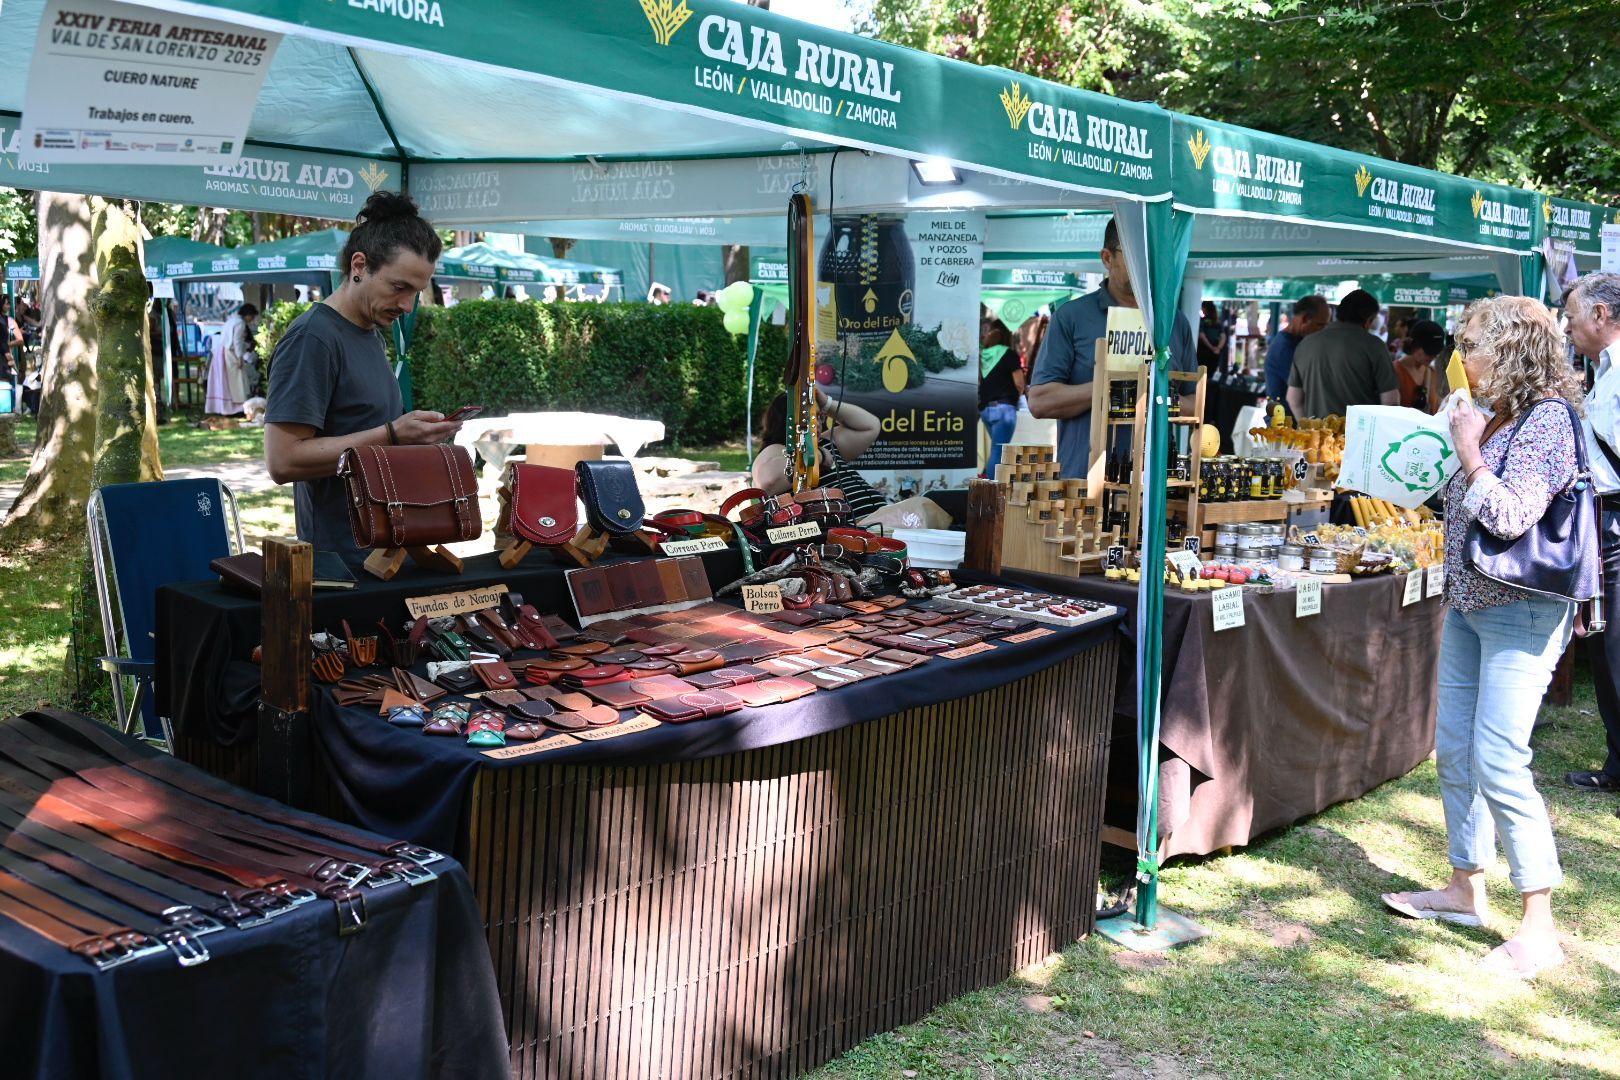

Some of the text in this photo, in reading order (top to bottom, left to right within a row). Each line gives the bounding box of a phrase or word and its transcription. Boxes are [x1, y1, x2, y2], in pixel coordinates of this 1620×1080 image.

[55, 10, 268, 51] XXIV FERIA ARTESANAL
[51, 28, 263, 66] VAL DE SAN LORENZO 2025
[698, 14, 901, 104] CAJA RURAL
[103, 69, 200, 90] CUERO NATURE
[694, 65, 734, 94] LEÓN
[750, 79, 833, 115] VALLADOLID
[846, 101, 898, 130] ZAMORA
[88, 106, 195, 125] Trabajos en cuero.
[1028, 101, 1153, 160] CAJA RURAL
[1028, 140, 1052, 162] LEÓN
[1061, 148, 1112, 173] VALLADOLID
[1120, 161, 1153, 181] ZAMORA
[1212, 145, 1304, 188] CAJA RURAL
[1236, 182, 1273, 201] VALLADOLID
[1277, 190, 1302, 206] ZAMORA
[1370, 177, 1436, 212] CAJA RURAL
[1368, 204, 1379, 216] LEÓN
[1480, 200, 1530, 227] CAJA RURAL
[1570, 208, 1591, 229] RURAL
[931, 221, 966, 230] MIEL DE
[919, 233, 978, 242] MANZANEDA
[929, 245, 968, 254] Y POZOS
[921, 257, 975, 266] DE CABRERA
[936, 271, 960, 288] León
[838, 316, 900, 329] Oro del Eria
[1107, 326, 1148, 356] PROPÓL
[882, 409, 964, 432] del Eria
[769, 525, 819, 542] Collares Perro
[665, 539, 724, 555] Correas Perro
[746, 587, 778, 599] Bolsas
[411, 600, 449, 615] Fundas
[453, 596, 466, 608] de
[750, 600, 780, 611] Perro
[1218, 601, 1240, 612] LABIAL
